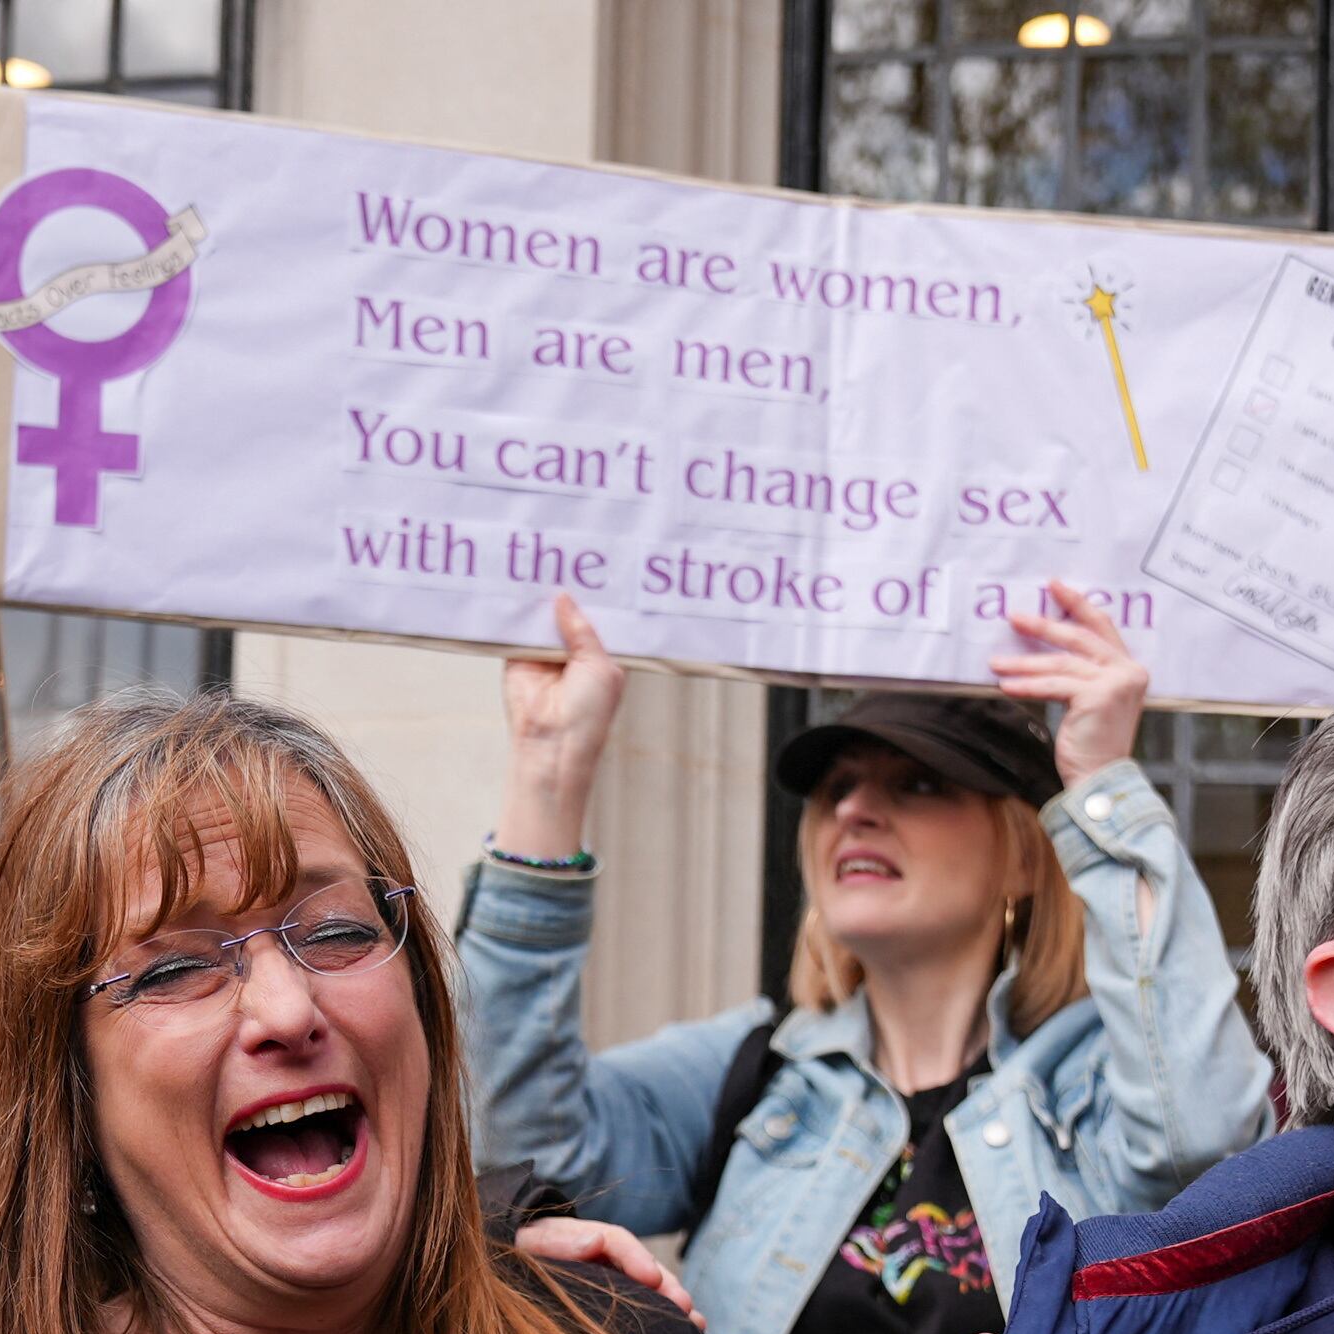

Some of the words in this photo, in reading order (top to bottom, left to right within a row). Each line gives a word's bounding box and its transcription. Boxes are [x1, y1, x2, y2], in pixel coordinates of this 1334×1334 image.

[44, 272, 95, 308] Over
[108, 251, 185, 289] Feelings
[355, 191, 601, 277] Women
[637, 243, 736, 294] are
[770, 260, 1023, 327] women,
[353, 295, 491, 361] Men
[532, 324, 634, 377] are
[674, 334, 831, 401] men,
[347, 409, 466, 472] You
[495, 438, 655, 495] can't
[685, 450, 919, 533] change
[957, 483, 1069, 528] sex
[342, 516, 477, 578] with
[506, 530, 608, 592] the
[642, 549, 845, 614] stroke
[873, 565, 940, 618] of
[974, 584, 1008, 621] a
